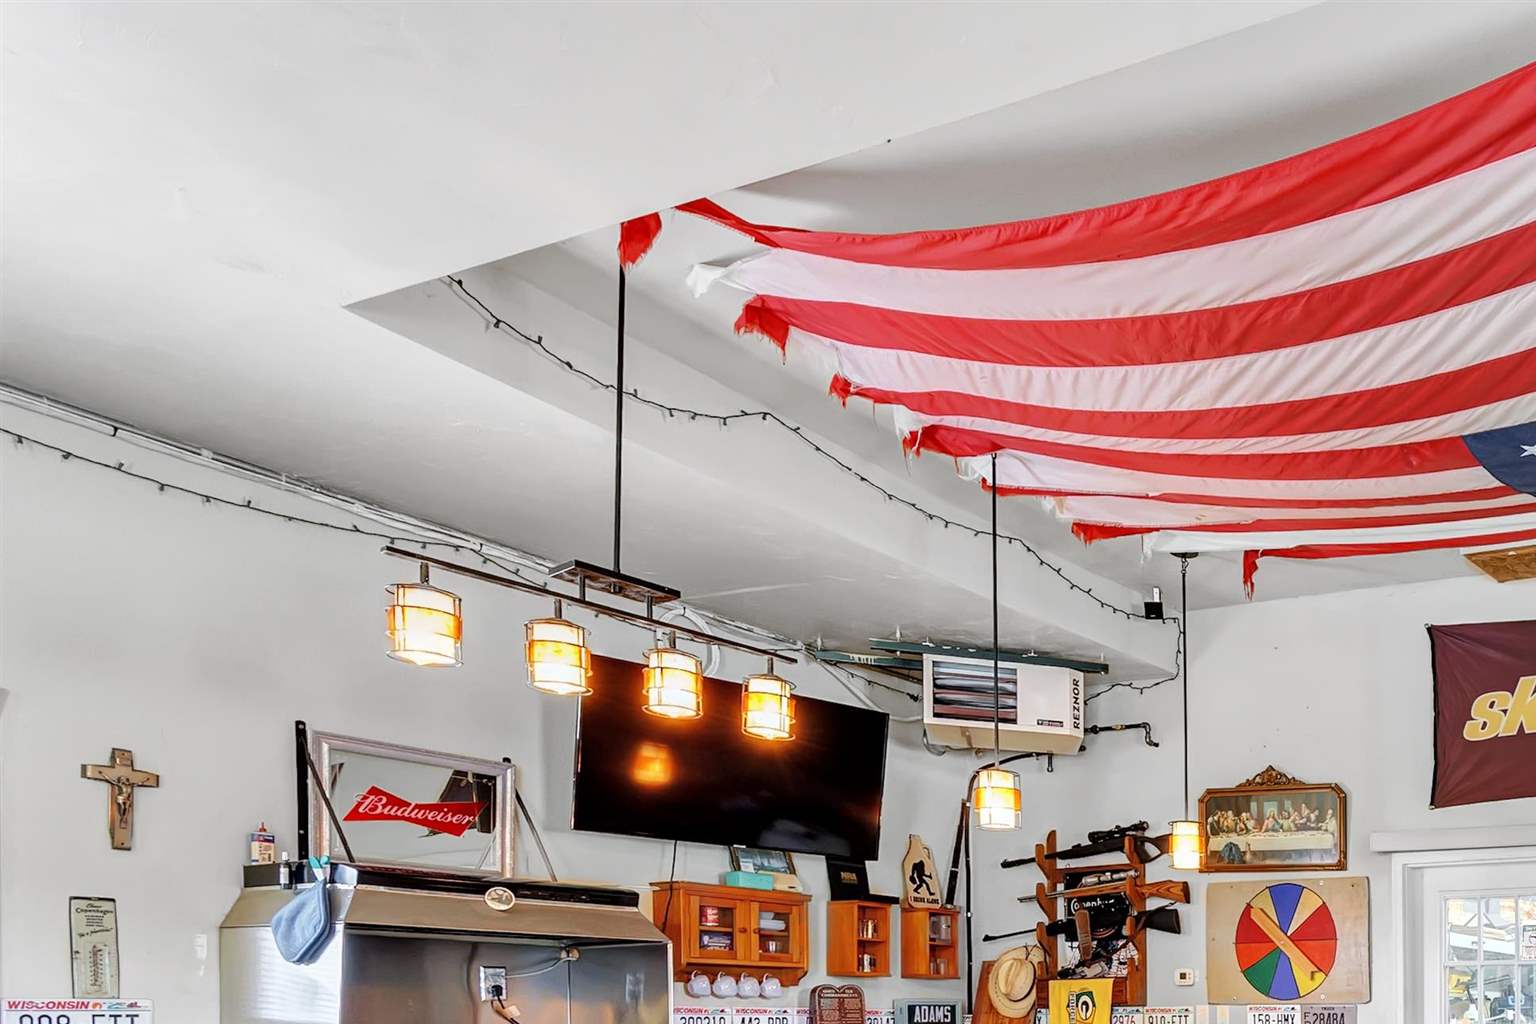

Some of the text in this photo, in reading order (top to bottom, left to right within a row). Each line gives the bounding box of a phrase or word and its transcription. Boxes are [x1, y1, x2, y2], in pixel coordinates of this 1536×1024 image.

[1072, 678, 1080, 730] REZNOR
[353, 793, 477, 825] Budweiser
[8, 1000, 90, 1010] WISCONSIN
[914, 1005, 951, 1023] ADAMS
